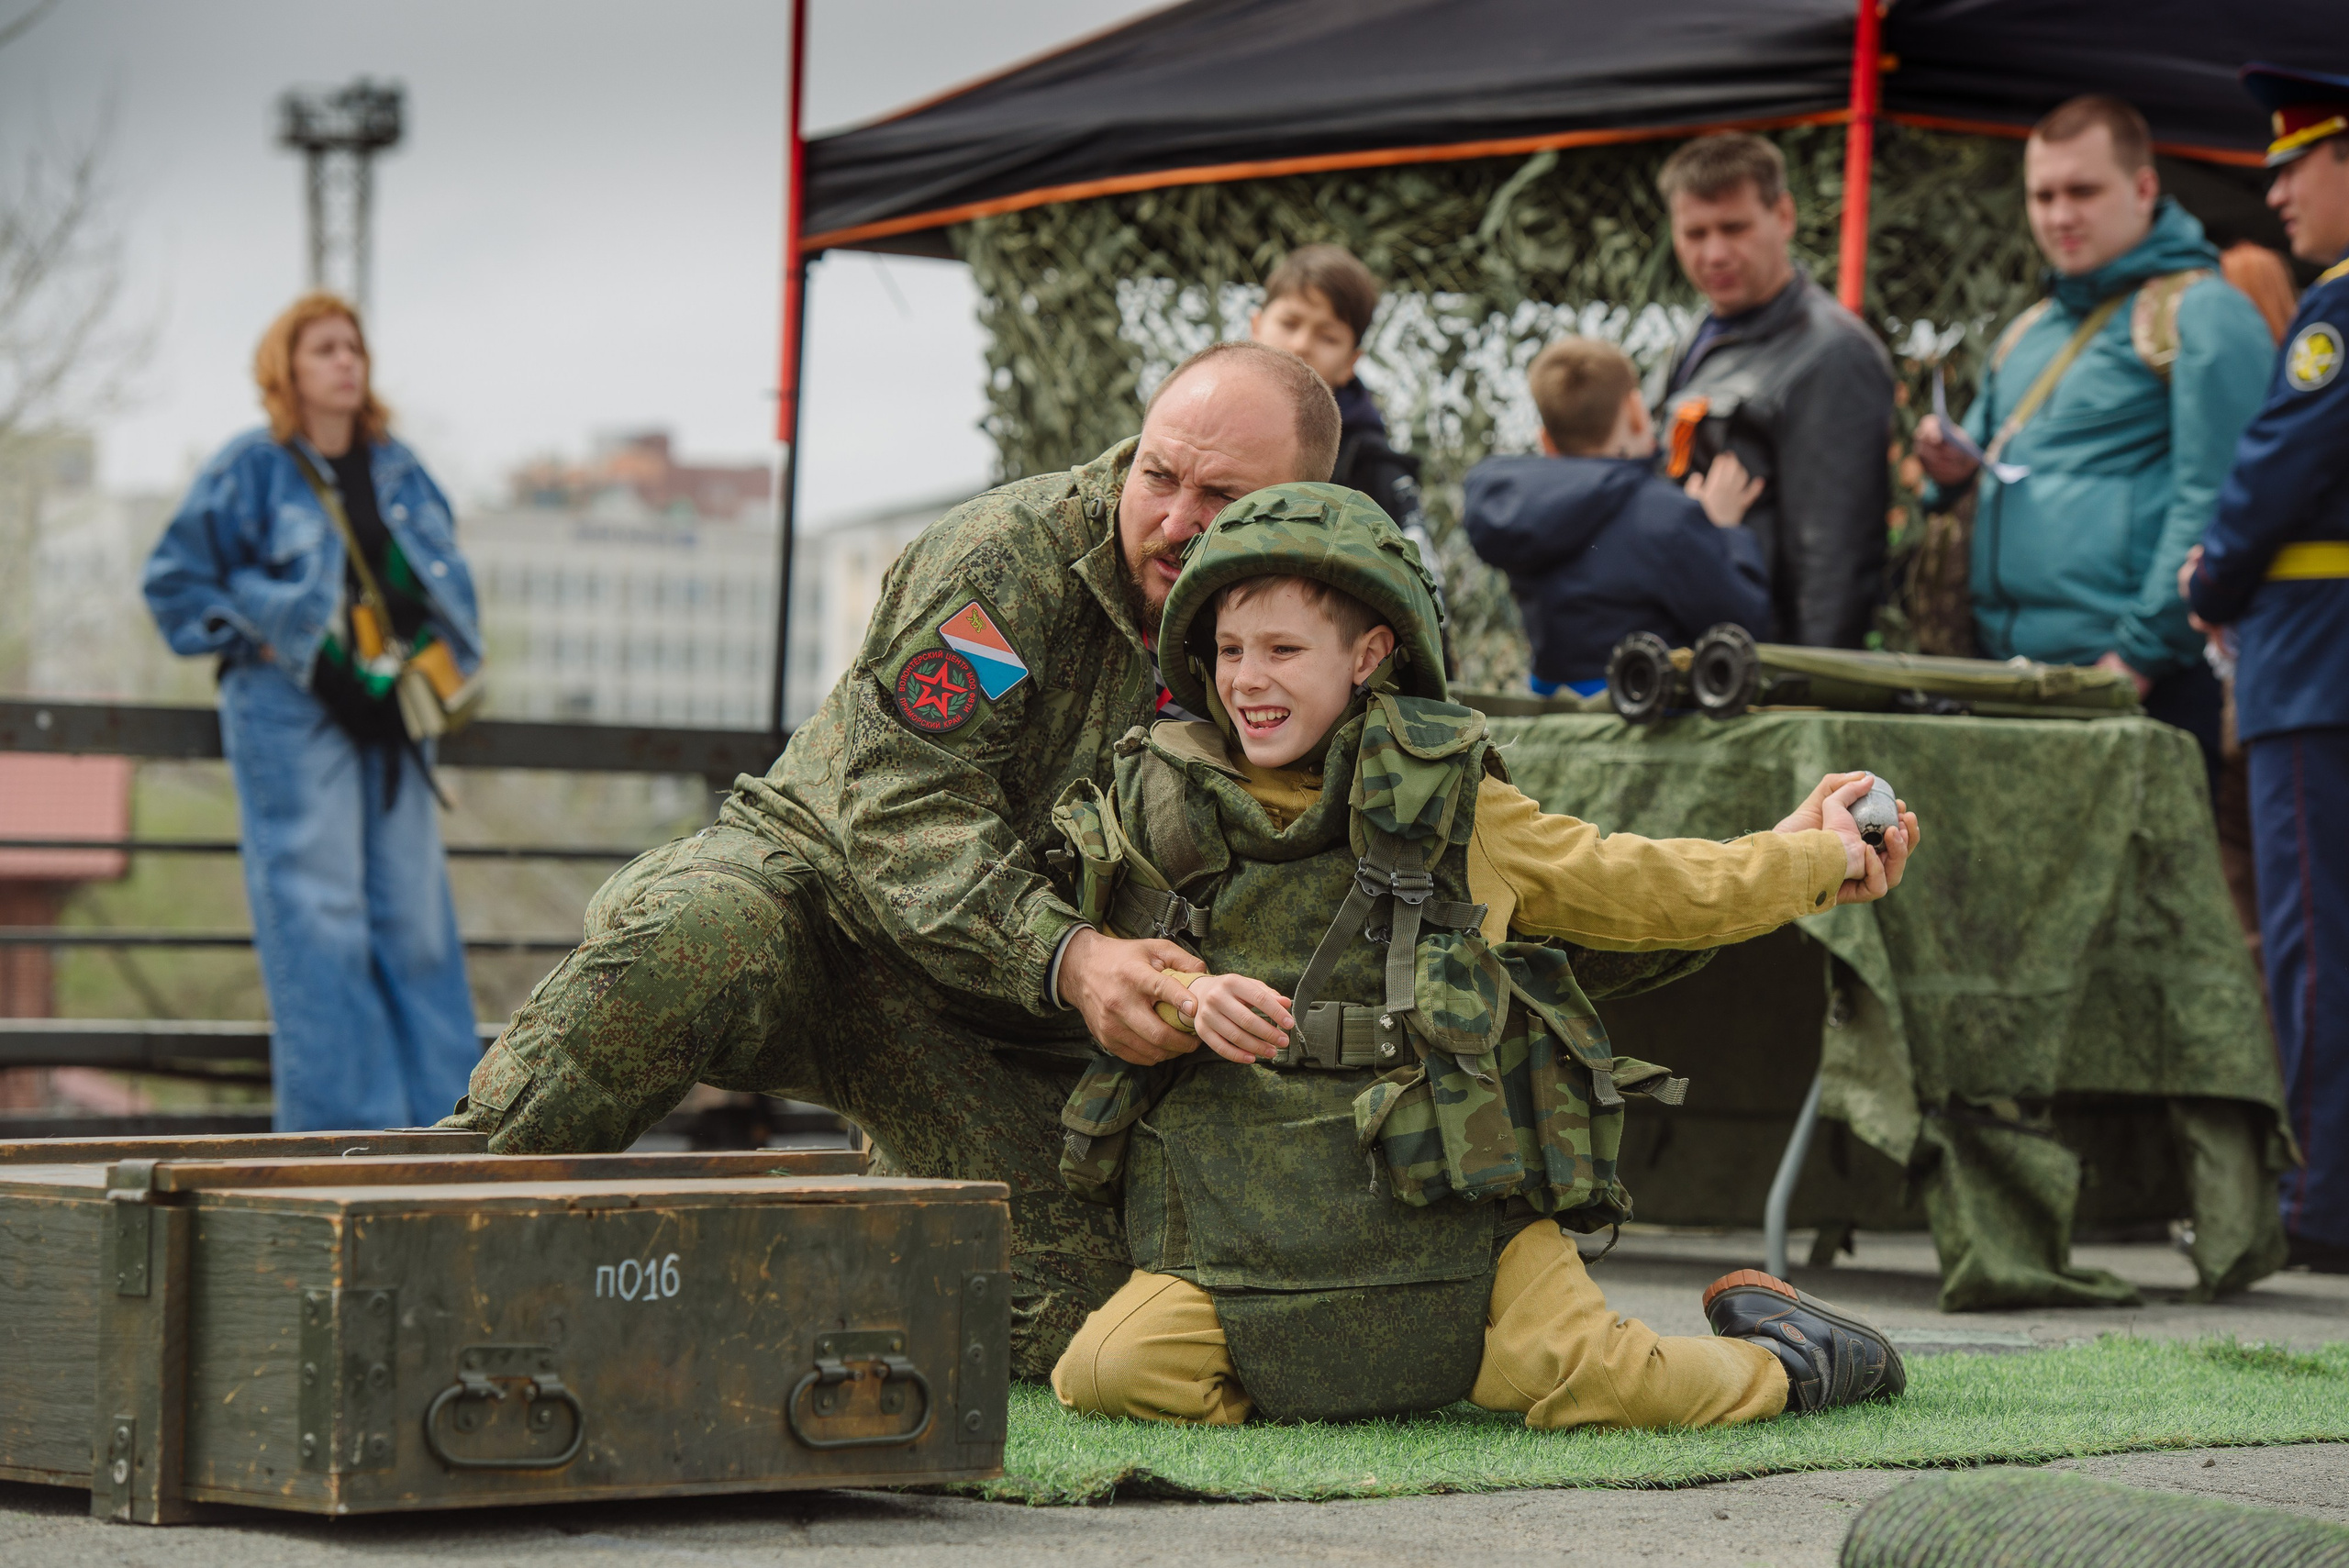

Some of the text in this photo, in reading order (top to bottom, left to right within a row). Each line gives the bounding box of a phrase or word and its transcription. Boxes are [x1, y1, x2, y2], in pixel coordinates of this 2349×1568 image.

[898, 651, 943, 692] ВОЛОНТЁРСКИЙ
[945, 652, 969, 671] ЦЕНТР
[966, 672, 976, 690] МОО
[899, 697, 963, 728] ПРИМОРСКИЙ КРАЙ
